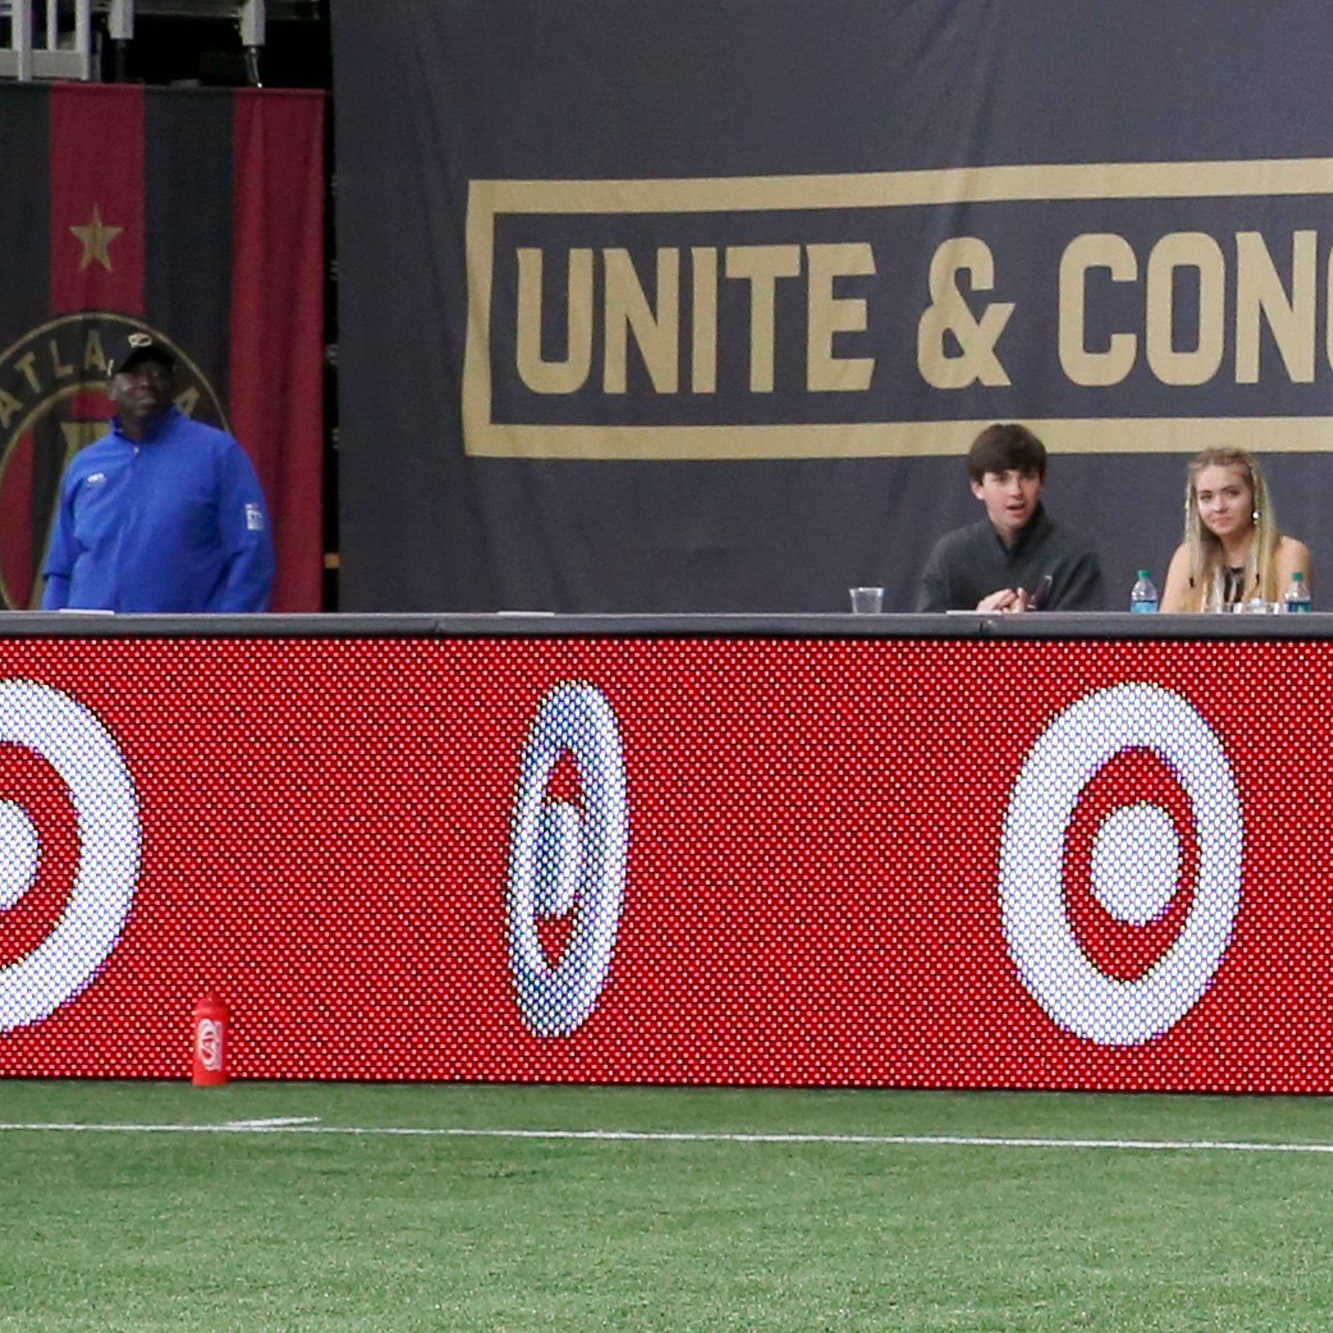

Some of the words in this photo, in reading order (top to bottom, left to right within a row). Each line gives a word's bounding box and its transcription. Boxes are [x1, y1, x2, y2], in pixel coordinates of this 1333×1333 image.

[0, 329, 200, 429] ATLAA
[516, 243, 876, 394] UNITE
[917, 235, 1013, 389] &
